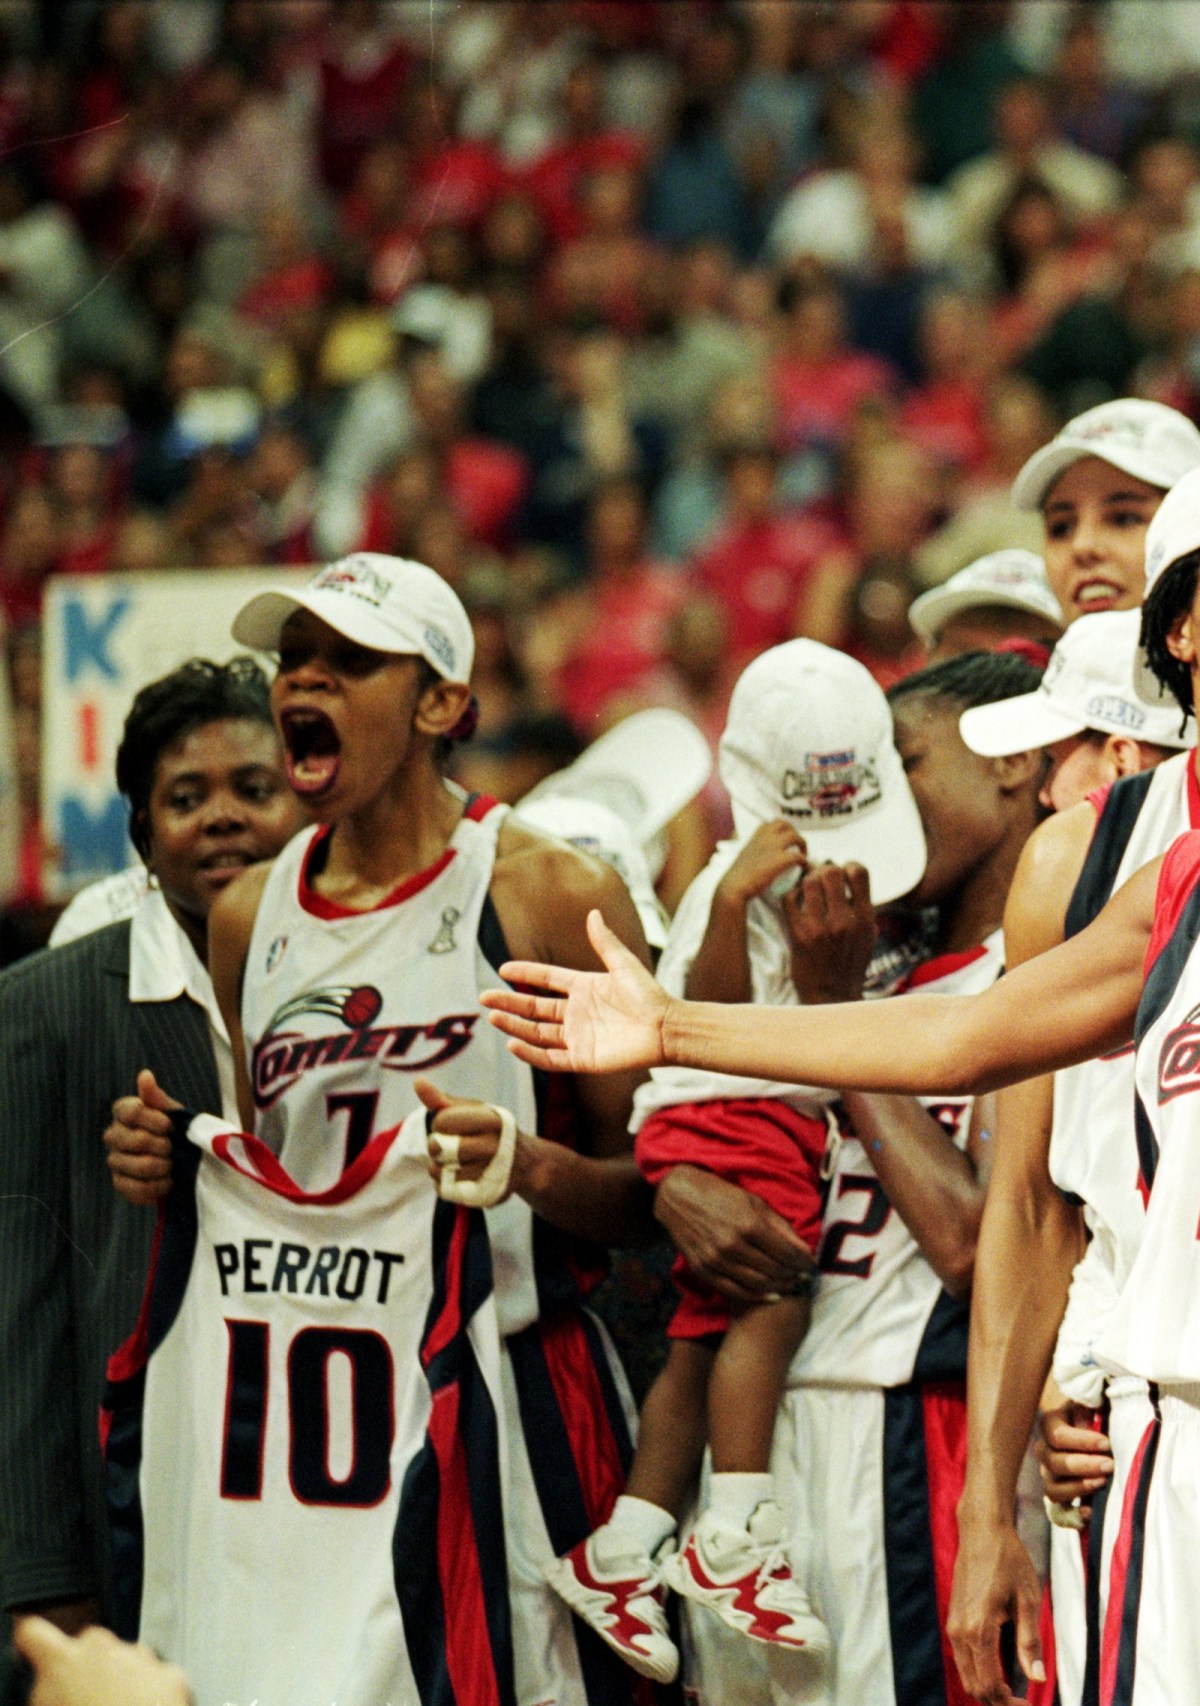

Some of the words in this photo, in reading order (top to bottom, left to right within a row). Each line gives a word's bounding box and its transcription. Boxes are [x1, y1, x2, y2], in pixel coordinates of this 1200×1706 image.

[253, 1014, 481, 1110] COMETS
[324, 1090, 381, 1175] 7
[215, 1238, 405, 1304] PERROT
[219, 1317, 395, 1509] 10
